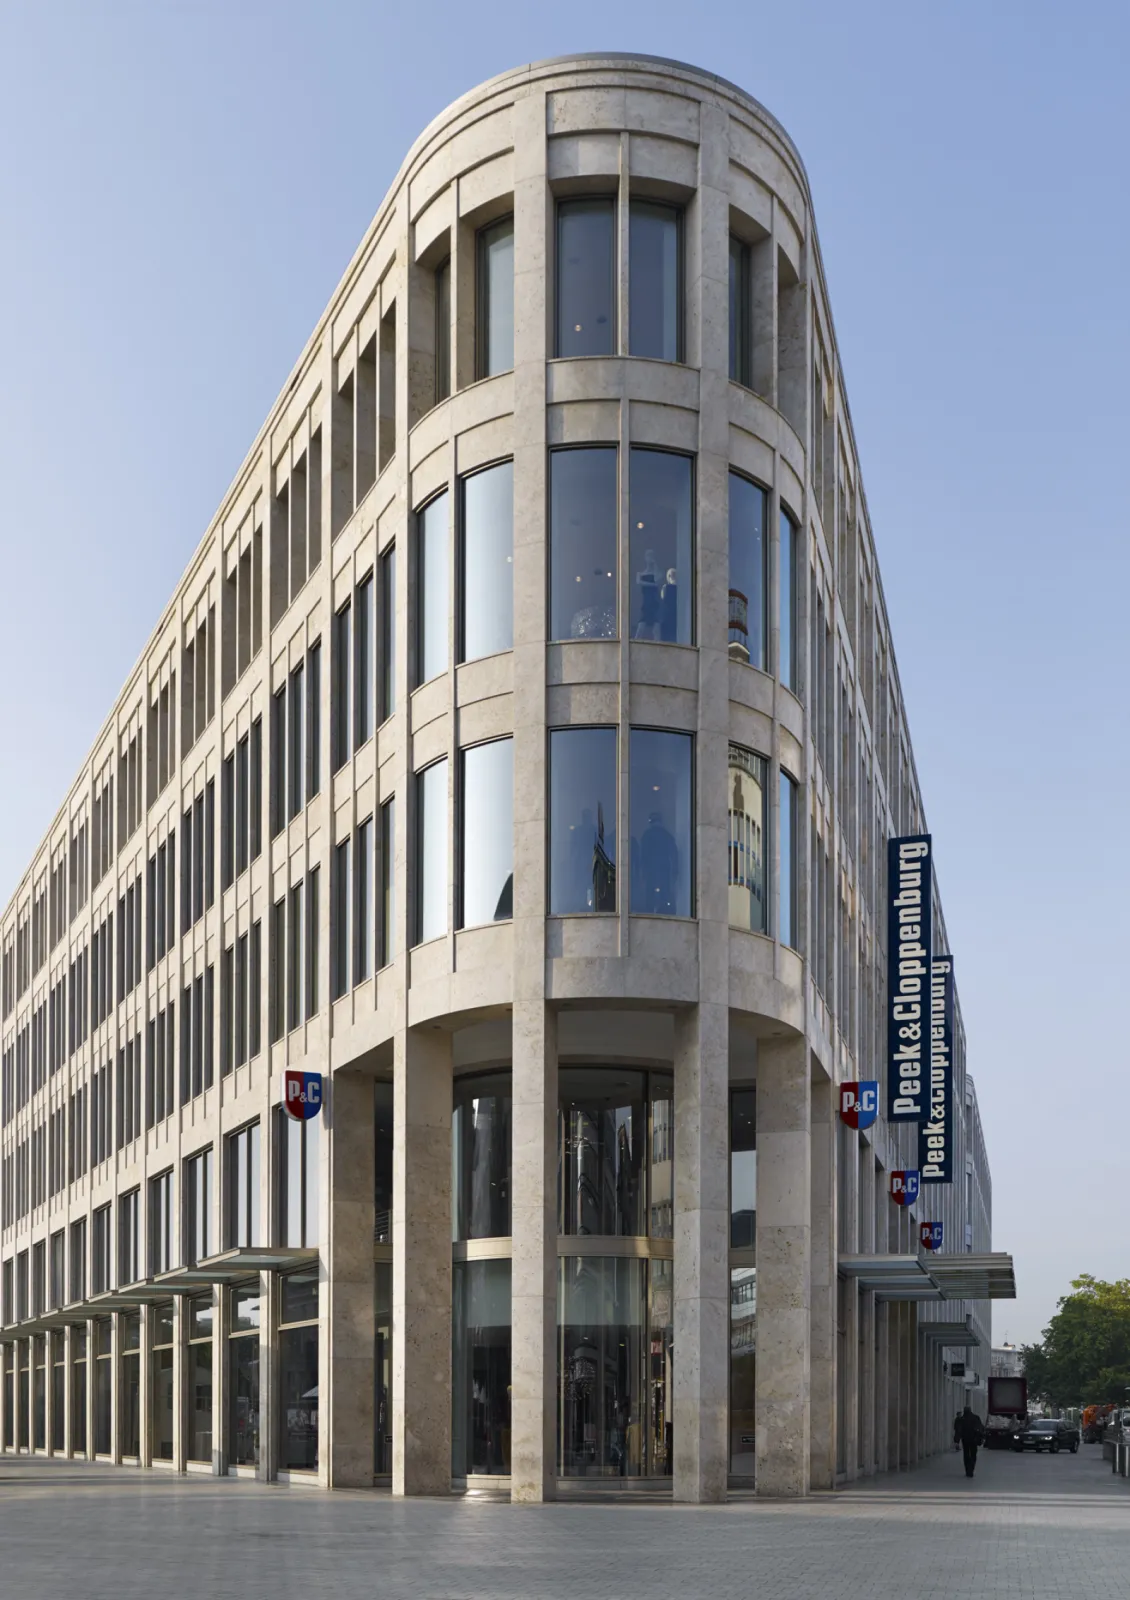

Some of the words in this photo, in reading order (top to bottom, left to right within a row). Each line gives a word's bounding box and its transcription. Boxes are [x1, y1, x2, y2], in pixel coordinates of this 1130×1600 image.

[288, 1080, 319, 1103] P&C
[842, 1090, 875, 1111] P&C
[892, 1177, 916, 1193] P&C
[922, 1226, 942, 1240] P&C
